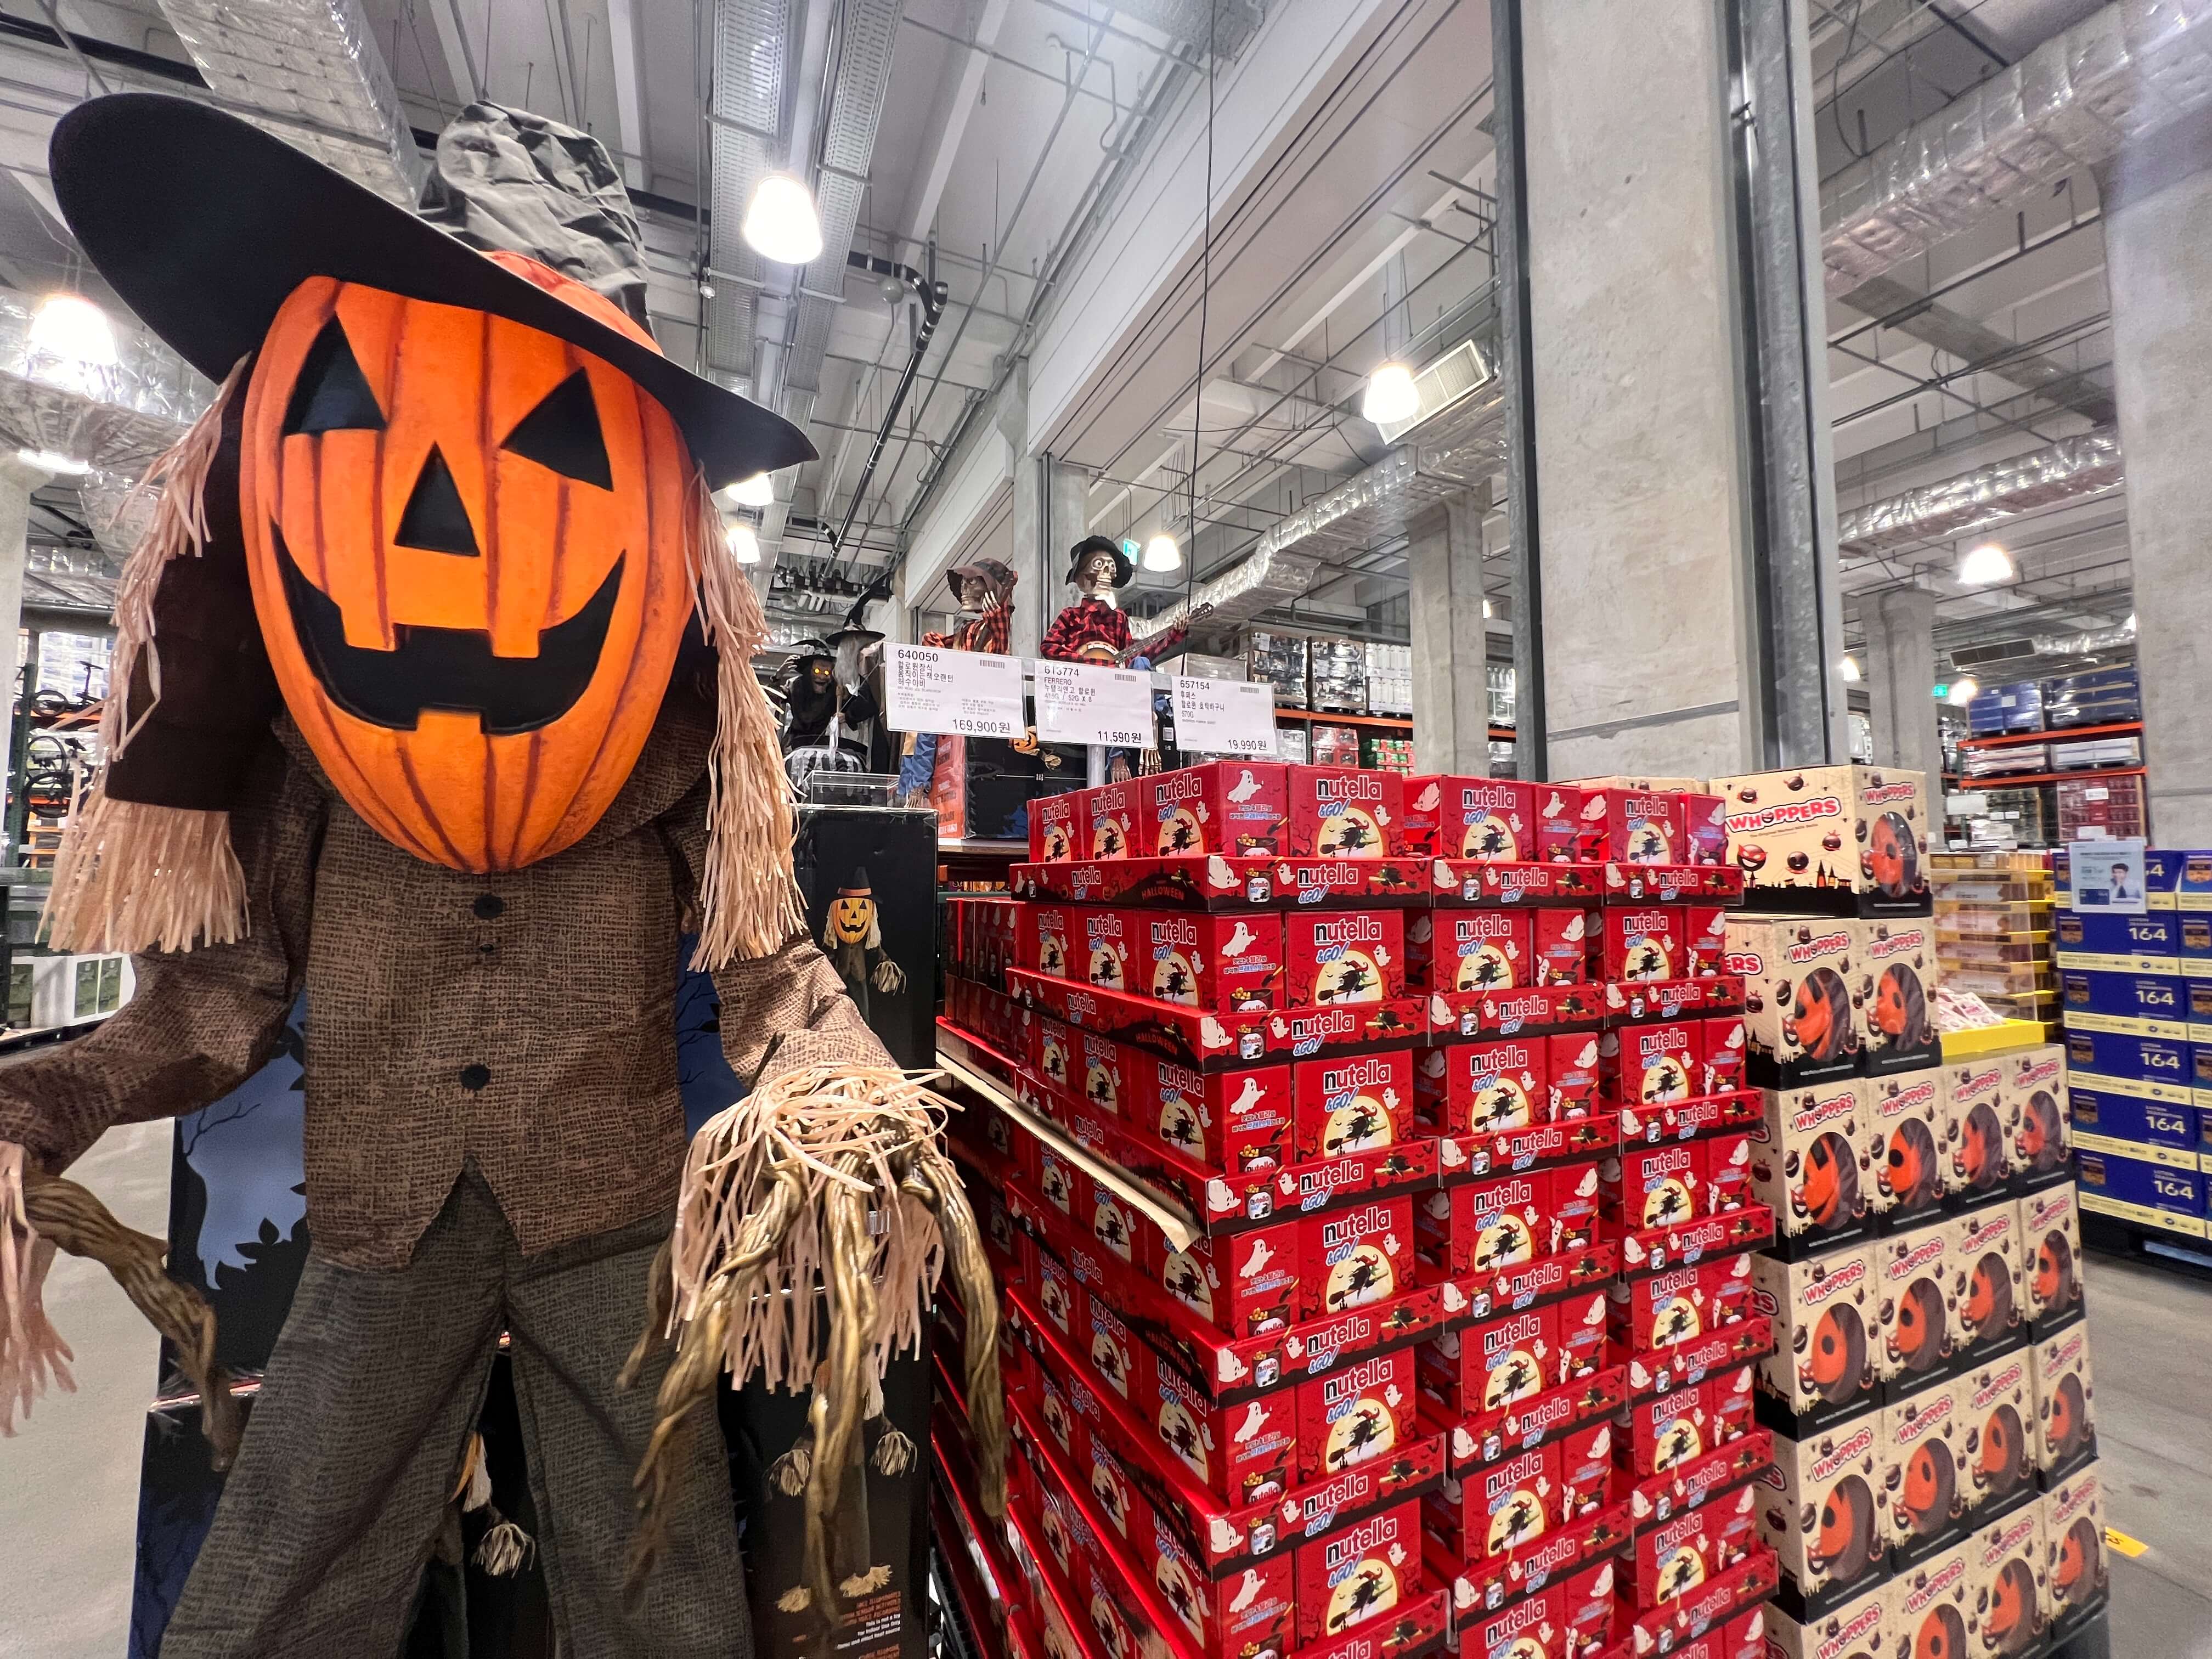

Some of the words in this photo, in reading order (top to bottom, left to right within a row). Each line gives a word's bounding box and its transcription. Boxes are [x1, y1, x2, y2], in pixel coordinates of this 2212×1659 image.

[898, 650, 938, 662] 640050
[898, 678, 925, 688] 허수아비
[1045, 665, 1079, 676] 613774
[1045, 677, 1072, 685] FERRERO
[1181, 680, 1210, 690] 657154
[953, 719, 1011, 733] 169,900원
[1098, 731, 1141, 743] 11,590원
[1228, 739, 1267, 751] 19,990원
[1156, 773, 1202, 805] nutella
[1317, 773, 1381, 800] nutella
[1463, 786, 1515, 809] nutella
[1042, 799, 1070, 823] nutella
[1091, 788, 1125, 816] nutella
[1318, 799, 1350, 818] &GO!
[1626, 795, 1668, 817] nutella
[1729, 799, 1839, 831] WHOPPERS
[1072, 865, 1101, 887] nutella
[1298, 863, 1358, 888] nutella
[1501, 868, 1548, 890] nutella
[1659, 870, 1697, 888] nutella
[1141, 887, 1185, 901] HALLOWEEN
[1299, 884, 1329, 904] &GO!
[1039, 911, 1063, 930] nutella
[1087, 914, 1122, 936] nutella
[1152, 919, 1196, 945] nutella
[1315, 916, 1381, 945] nutella
[1456, 915, 1511, 941] nutella
[1623, 912, 1668, 934] nutella
[1790, 933, 1849, 961] WHOPPERS
[2129, 928, 2168, 941] 164
[1316, 942, 1350, 964] &GO!
[1067, 994, 1096, 1014] nutella
[1500, 996, 1548, 1020] nutella
[1661, 984, 1700, 1005] nutella
[2136, 990, 2175, 1005] 164
[1292, 1011, 1355, 1039] nutella
[1084, 1034, 1116, 1062] nutella
[1293, 1035, 1324, 1056] &GO!
[1640, 1032, 1687, 1055] nutella
[1470, 1045, 1528, 1076] nutella
[2140, 1052, 2180, 1069] 164
[1159, 1062, 1204, 1098] nutella
[1324, 1059, 1391, 1093] nutella
[1325, 1087, 1359, 1112] &GO!
[1796, 1094, 1854, 1131] WHOPPERS
[1678, 1102, 1718, 1126] nutella
[2146, 1116, 2186, 1134] 164
[1075, 1115, 1104, 1144] nutella
[1511, 1128, 1562, 1155] nutella
[1300, 1160, 1363, 1194] nutella
[1643, 1149, 1690, 1178] nutella
[1301, 1187, 1333, 1211] &GO!
[1475, 1181, 1532, 1214] nutella
[2153, 1180, 2194, 1200] 164
[1323, 1208, 1391, 1248] nutella
[1682, 1223, 1723, 1250] nutella
[1071, 1246, 1103, 1284] nutella
[1325, 1237, 1359, 1266] &GO!
[1040, 1247, 1066, 1285] nutella
[1513, 1263, 1562, 1294] nutella
[1651, 1267, 1697, 1299] nutella
[1090, 1290, 1126, 1342] nutella
[1307, 1317, 1369, 1356] nutella
[1485, 1314, 1540, 1354] nutella
[1308, 1346, 1339, 1374] &GO!
[1687, 1341, 1727, 1372] nutella
[1324, 1357, 1393, 1406] nutella
[1325, 1390, 1361, 1425] &GO!
[1521, 1397, 1570, 1434] nutella
[1652, 1388, 1699, 1424] nutella
[1487, 1453, 1543, 1499] nutella
[1687, 1460, 1727, 1495] nutella
[1304, 1474, 1368, 1520] nutella
[1305, 1505, 1337, 1537] &GO!
[1655, 1513, 1703, 1552] nutella
[1327, 1516, 1397, 1569] nutella
[1328, 1553, 1363, 1588] &GO!
[1525, 1538, 1575, 1577] nutella
[1690, 1588, 1731, 1623] nutella
[1486, 1599, 1546, 1648] nutella
